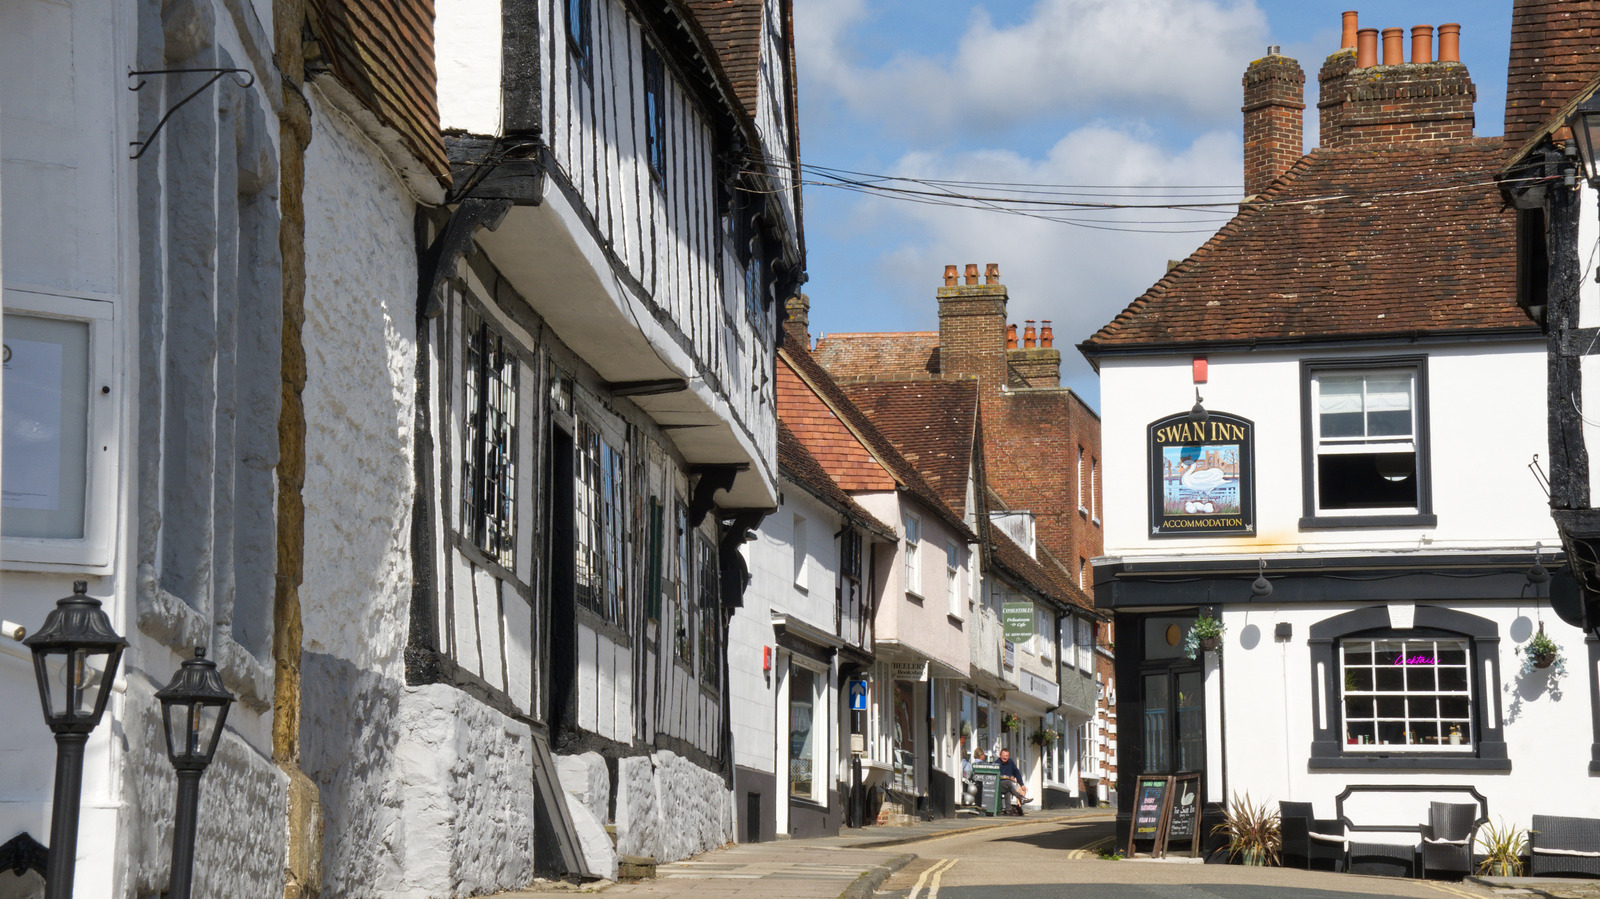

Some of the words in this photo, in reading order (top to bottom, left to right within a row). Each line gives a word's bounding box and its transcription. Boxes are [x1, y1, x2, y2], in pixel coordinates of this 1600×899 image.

[1156, 421, 1206, 443] SWAN
[1211, 421, 1246, 442] INN
[1162, 517, 1243, 528] ACCOMMODATION
[1394, 654, 1442, 665] Ccktail
